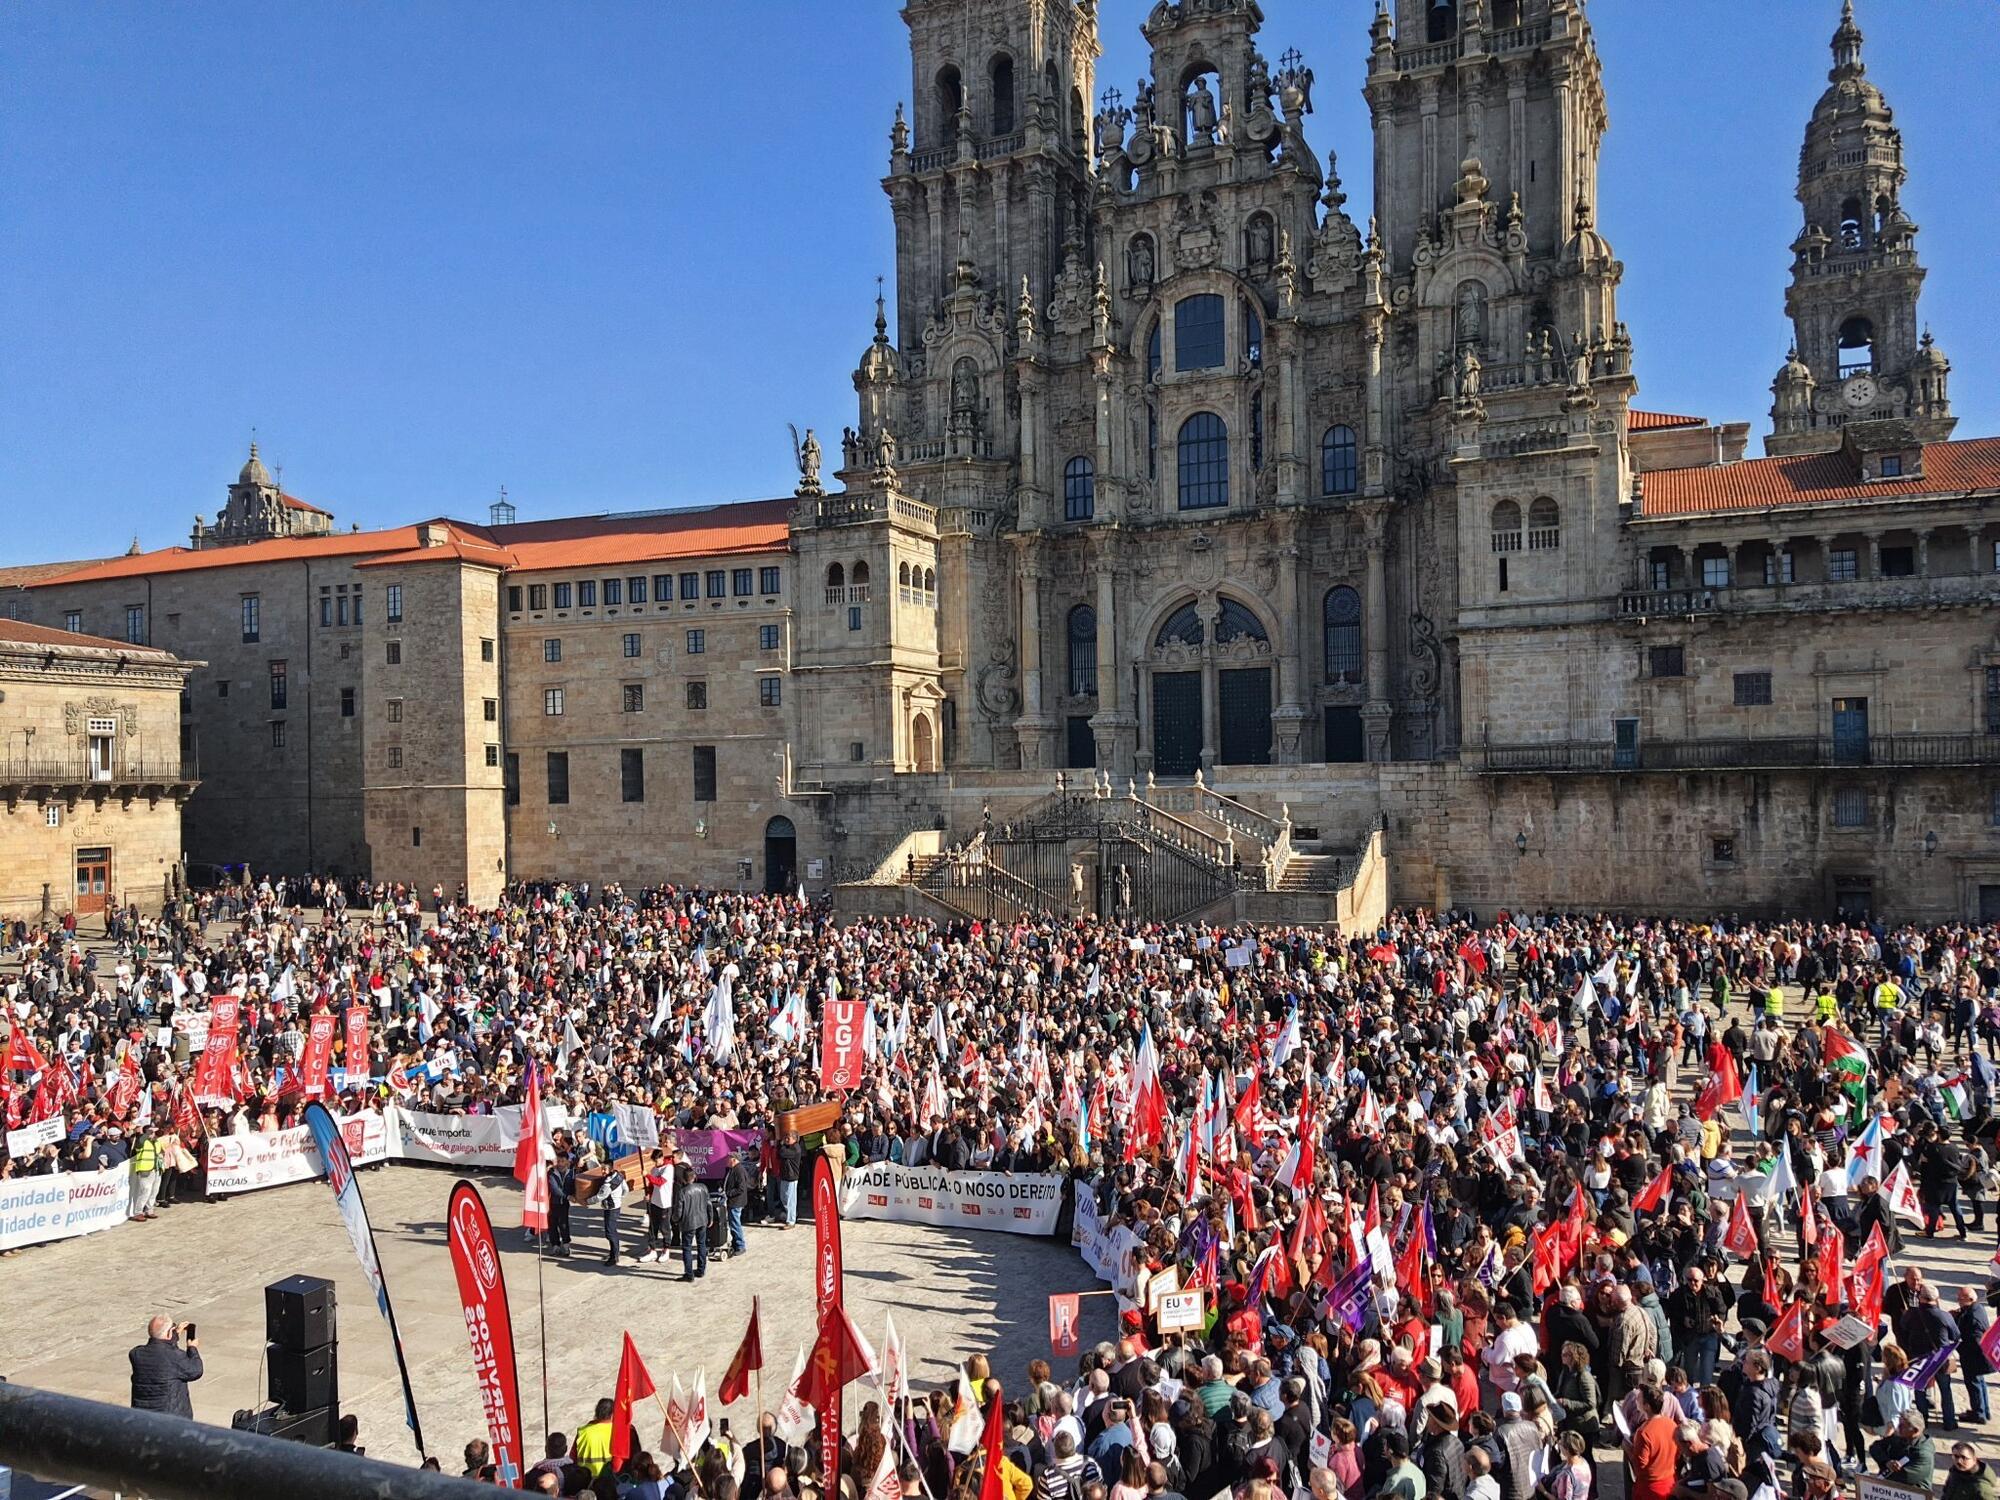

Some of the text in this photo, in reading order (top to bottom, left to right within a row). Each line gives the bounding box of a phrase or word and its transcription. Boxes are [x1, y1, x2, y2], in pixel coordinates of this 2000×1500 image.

[834, 1003, 853, 1068] UGT
[352, 1034, 362, 1075] UGT
[311, 1043, 324, 1086] UGT
[437, 1127, 472, 1138] importa:
[953, 1180, 961, 1195] O
[966, 1181, 1005, 1198] NOSO
[1009, 1183, 1056, 1200] DEREITO
[52, 1213, 61, 1226] e
[1166, 1298, 1180, 1309] EU
[1872, 1486, 1891, 1497] NON
